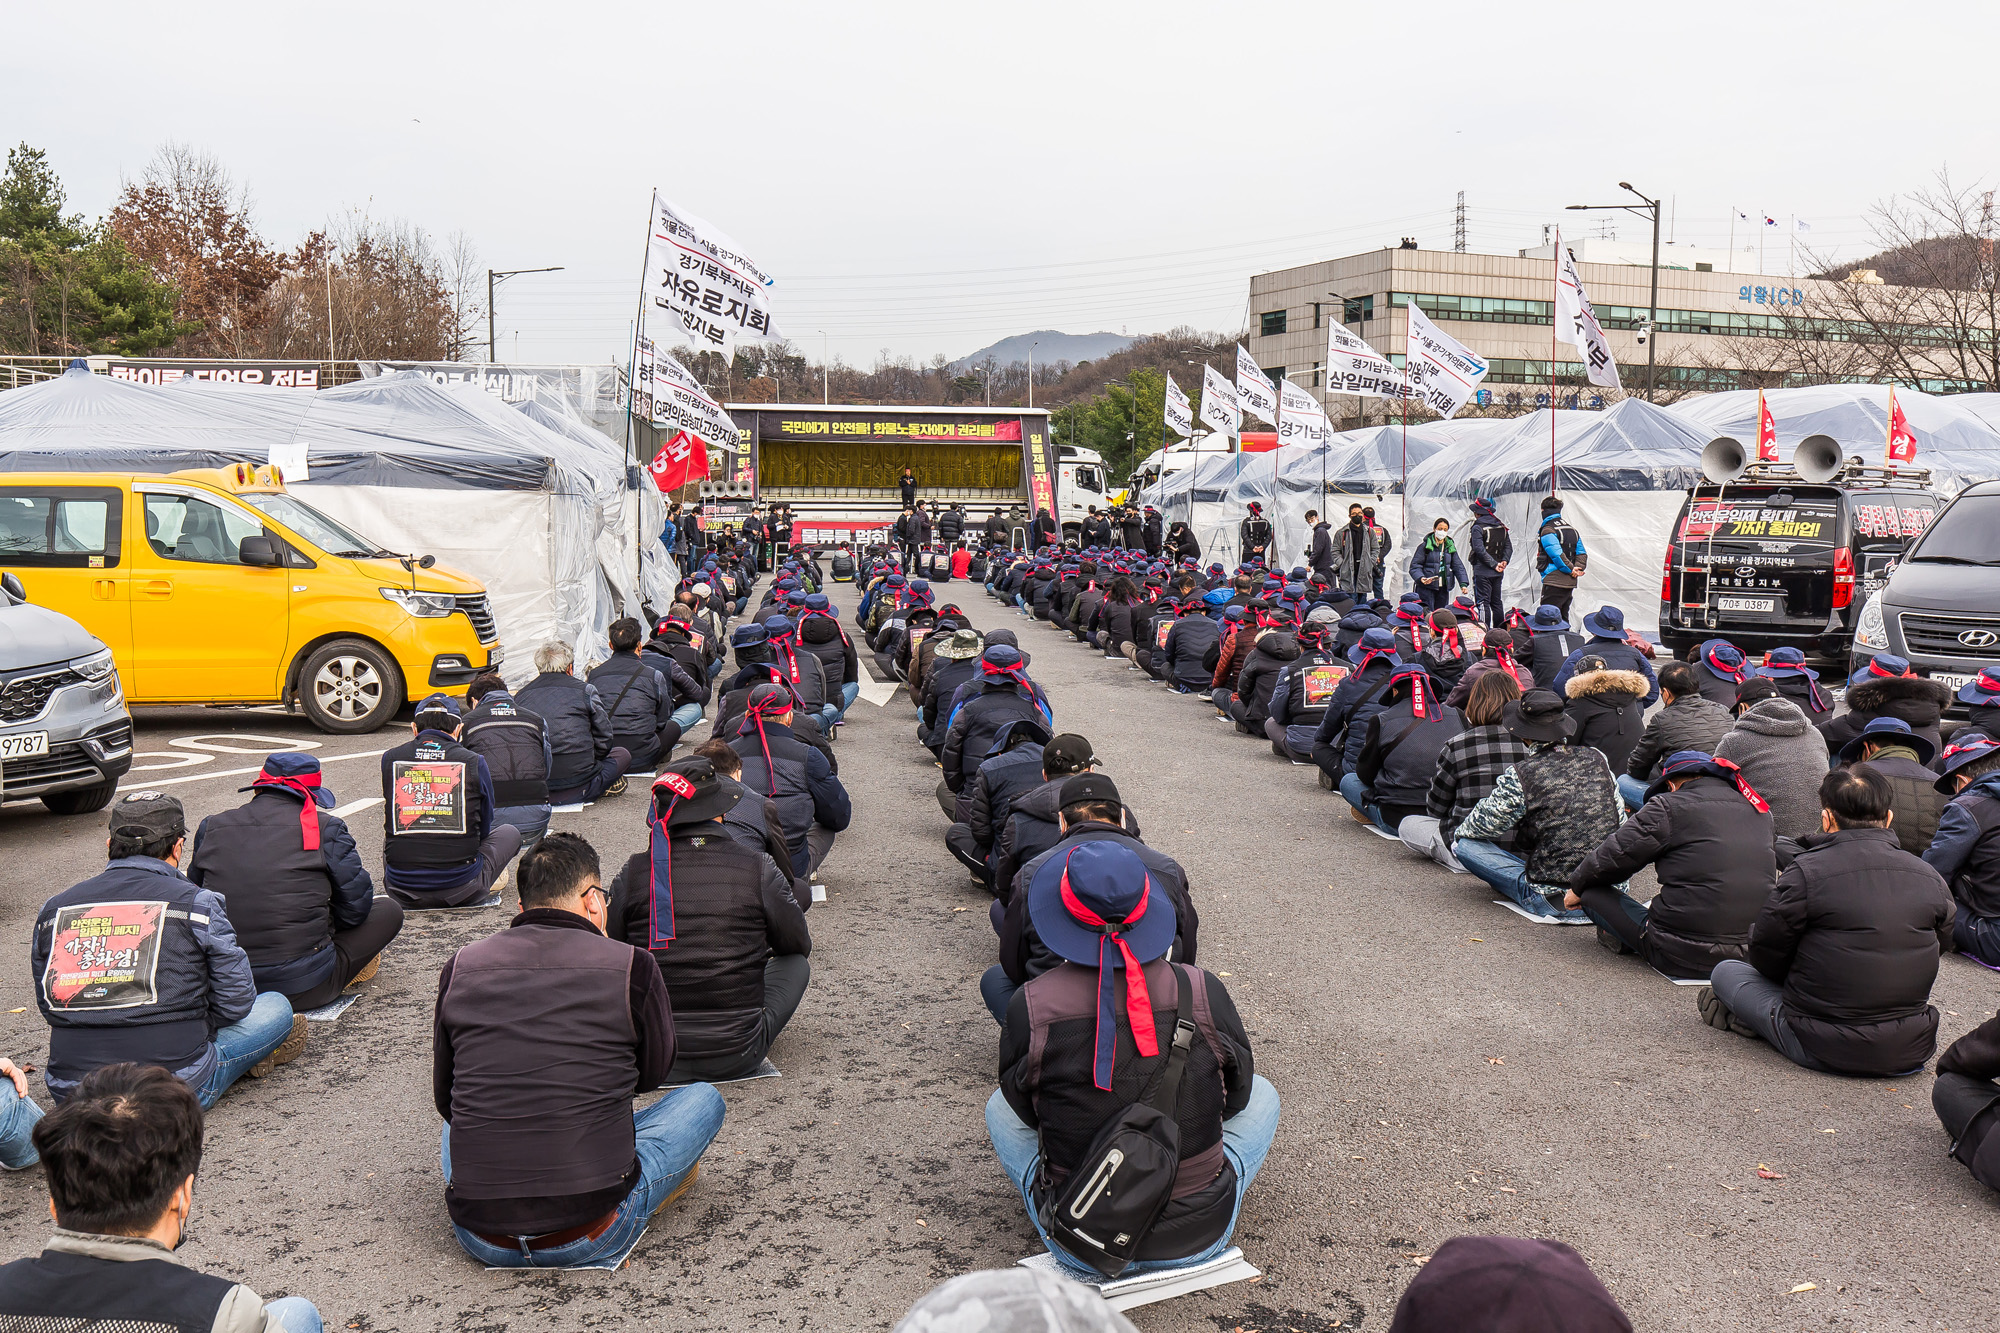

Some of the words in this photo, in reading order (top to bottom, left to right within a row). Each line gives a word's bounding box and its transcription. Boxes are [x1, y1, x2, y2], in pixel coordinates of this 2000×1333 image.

[679, 253, 756, 298] 경기북부지부
[661, 268, 771, 336] 자유로지회
[1739, 285, 1804, 306] 의왕ICD
[1421, 336, 1472, 374] 서울경기지역본부
[673, 389, 719, 418] 편의점지부
[781, 420, 830, 434] 국민에게
[832, 423, 871, 435] 안전을!
[873, 422, 955, 436] 화물노동자에게
[957, 424, 996, 437] 권리를!
[1690, 509, 1759, 524] 안전운임제
[1760, 509, 1797, 523] 확대!
[1730, 521, 1767, 536] 가자!
[1768, 522, 1821, 537] 총파업!
[1739, 556, 1795, 567] 서울경기지역본부
[1744, 600, 1769, 610] 0387
[2, 736, 43, 755] 9787
[401, 782, 430, 794] 가자!
[70, 918, 113, 930] 안전운임
[113, 925, 141, 936] 폐지!
[64, 936, 107, 955] 가자!
[77, 948, 139, 970] 총파업!
